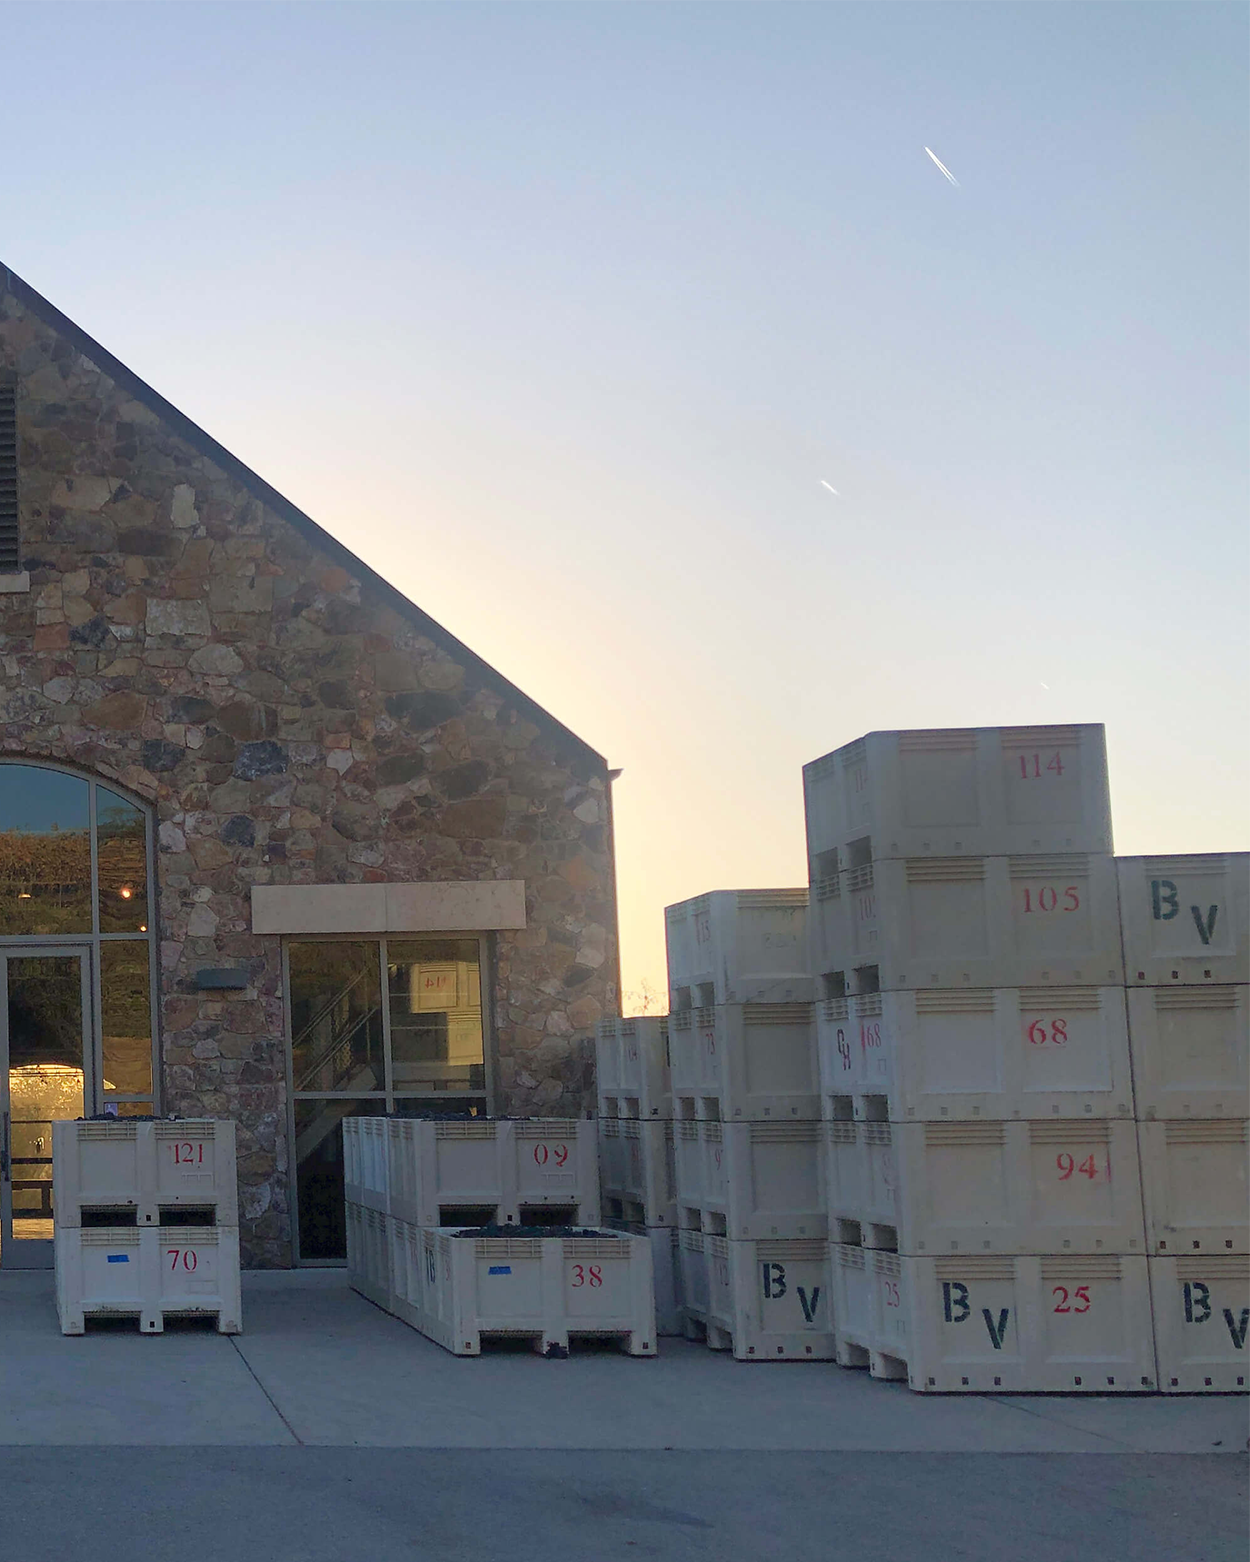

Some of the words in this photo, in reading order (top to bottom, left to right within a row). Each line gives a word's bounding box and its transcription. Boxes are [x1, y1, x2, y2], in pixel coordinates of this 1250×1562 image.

[1019, 752, 1065, 779] 114
[1023, 886, 1081, 914] 105
[1027, 1019, 1069, 1046] 68
[173, 1142, 204, 1166] 121
[533, 1144, 569, 1168] 09
[1055, 1152, 1100, 1181] 94
[167, 1249, 198, 1272] 70
[572, 1263, 604, 1288] 38
[1052, 1285, 1092, 1314] 25
